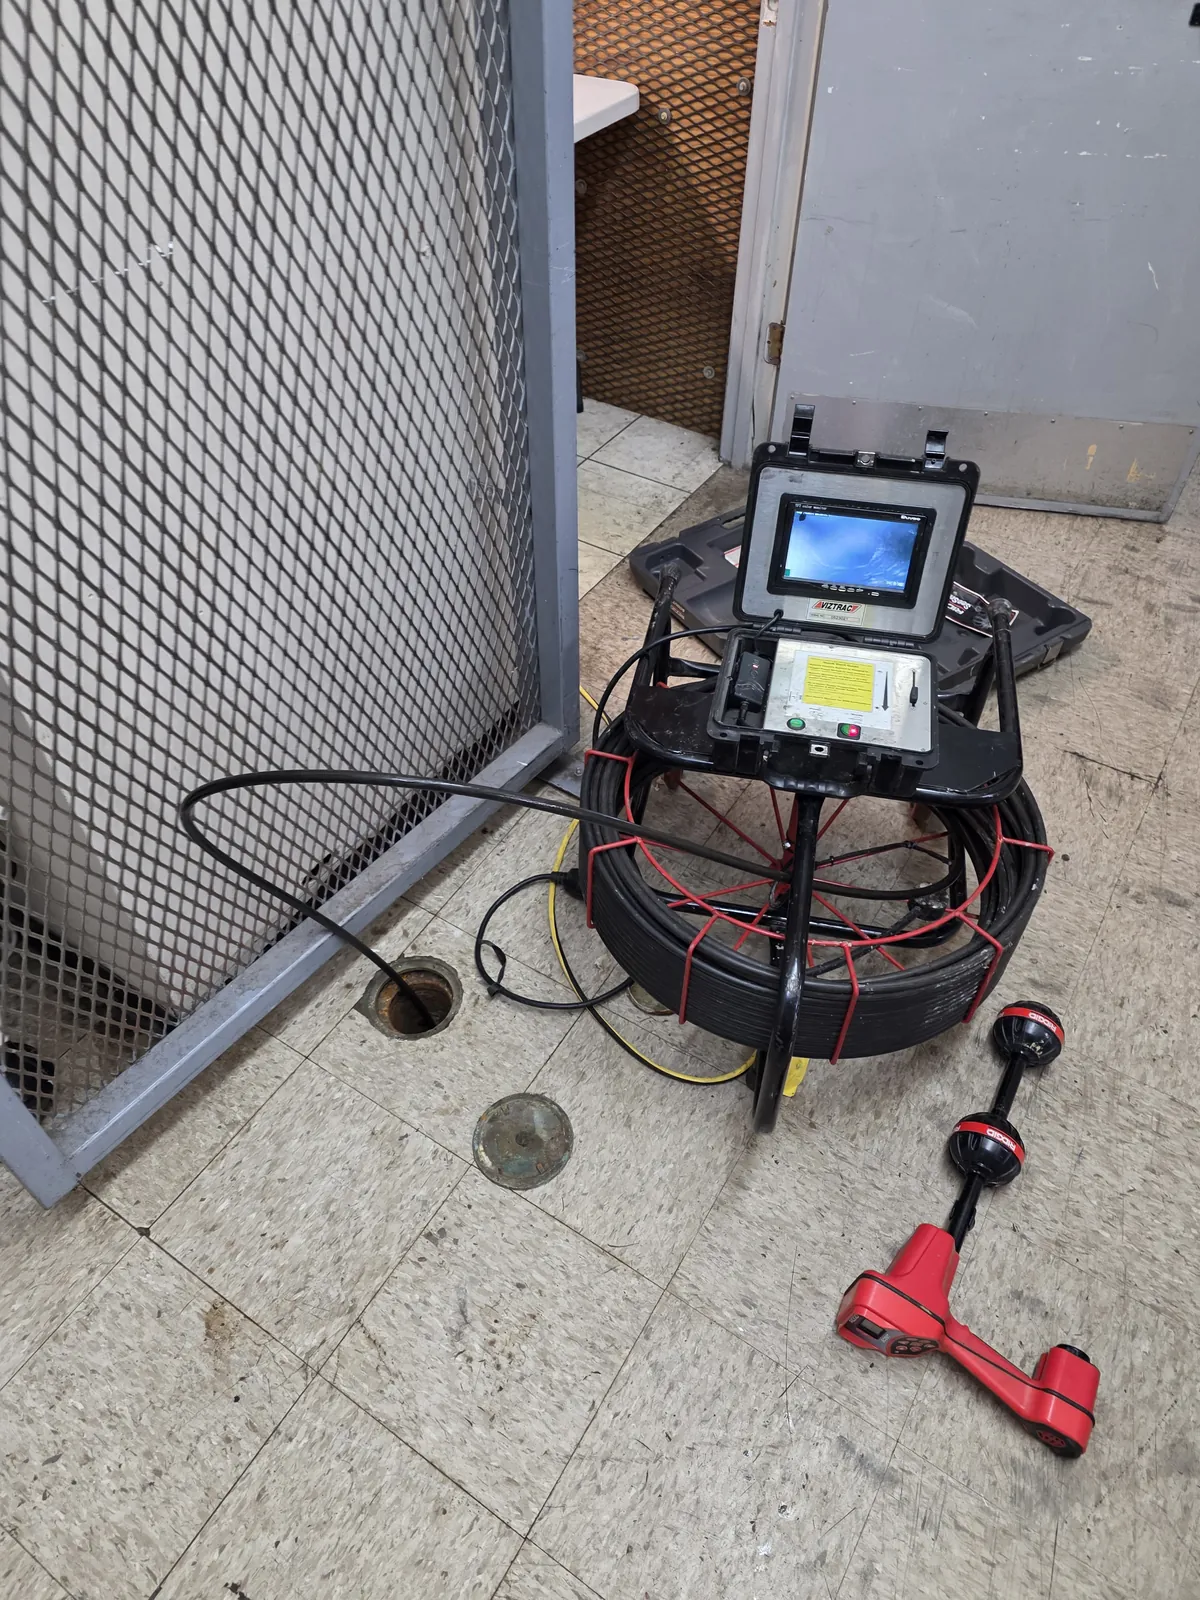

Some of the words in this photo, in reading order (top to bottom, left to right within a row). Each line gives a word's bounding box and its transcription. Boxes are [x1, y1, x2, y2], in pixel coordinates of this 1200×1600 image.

[821, 601, 853, 612] VIZTRAC
[1028, 1012, 1057, 1032] RIDGID
[986, 1128, 1016, 1152] RIDGID
